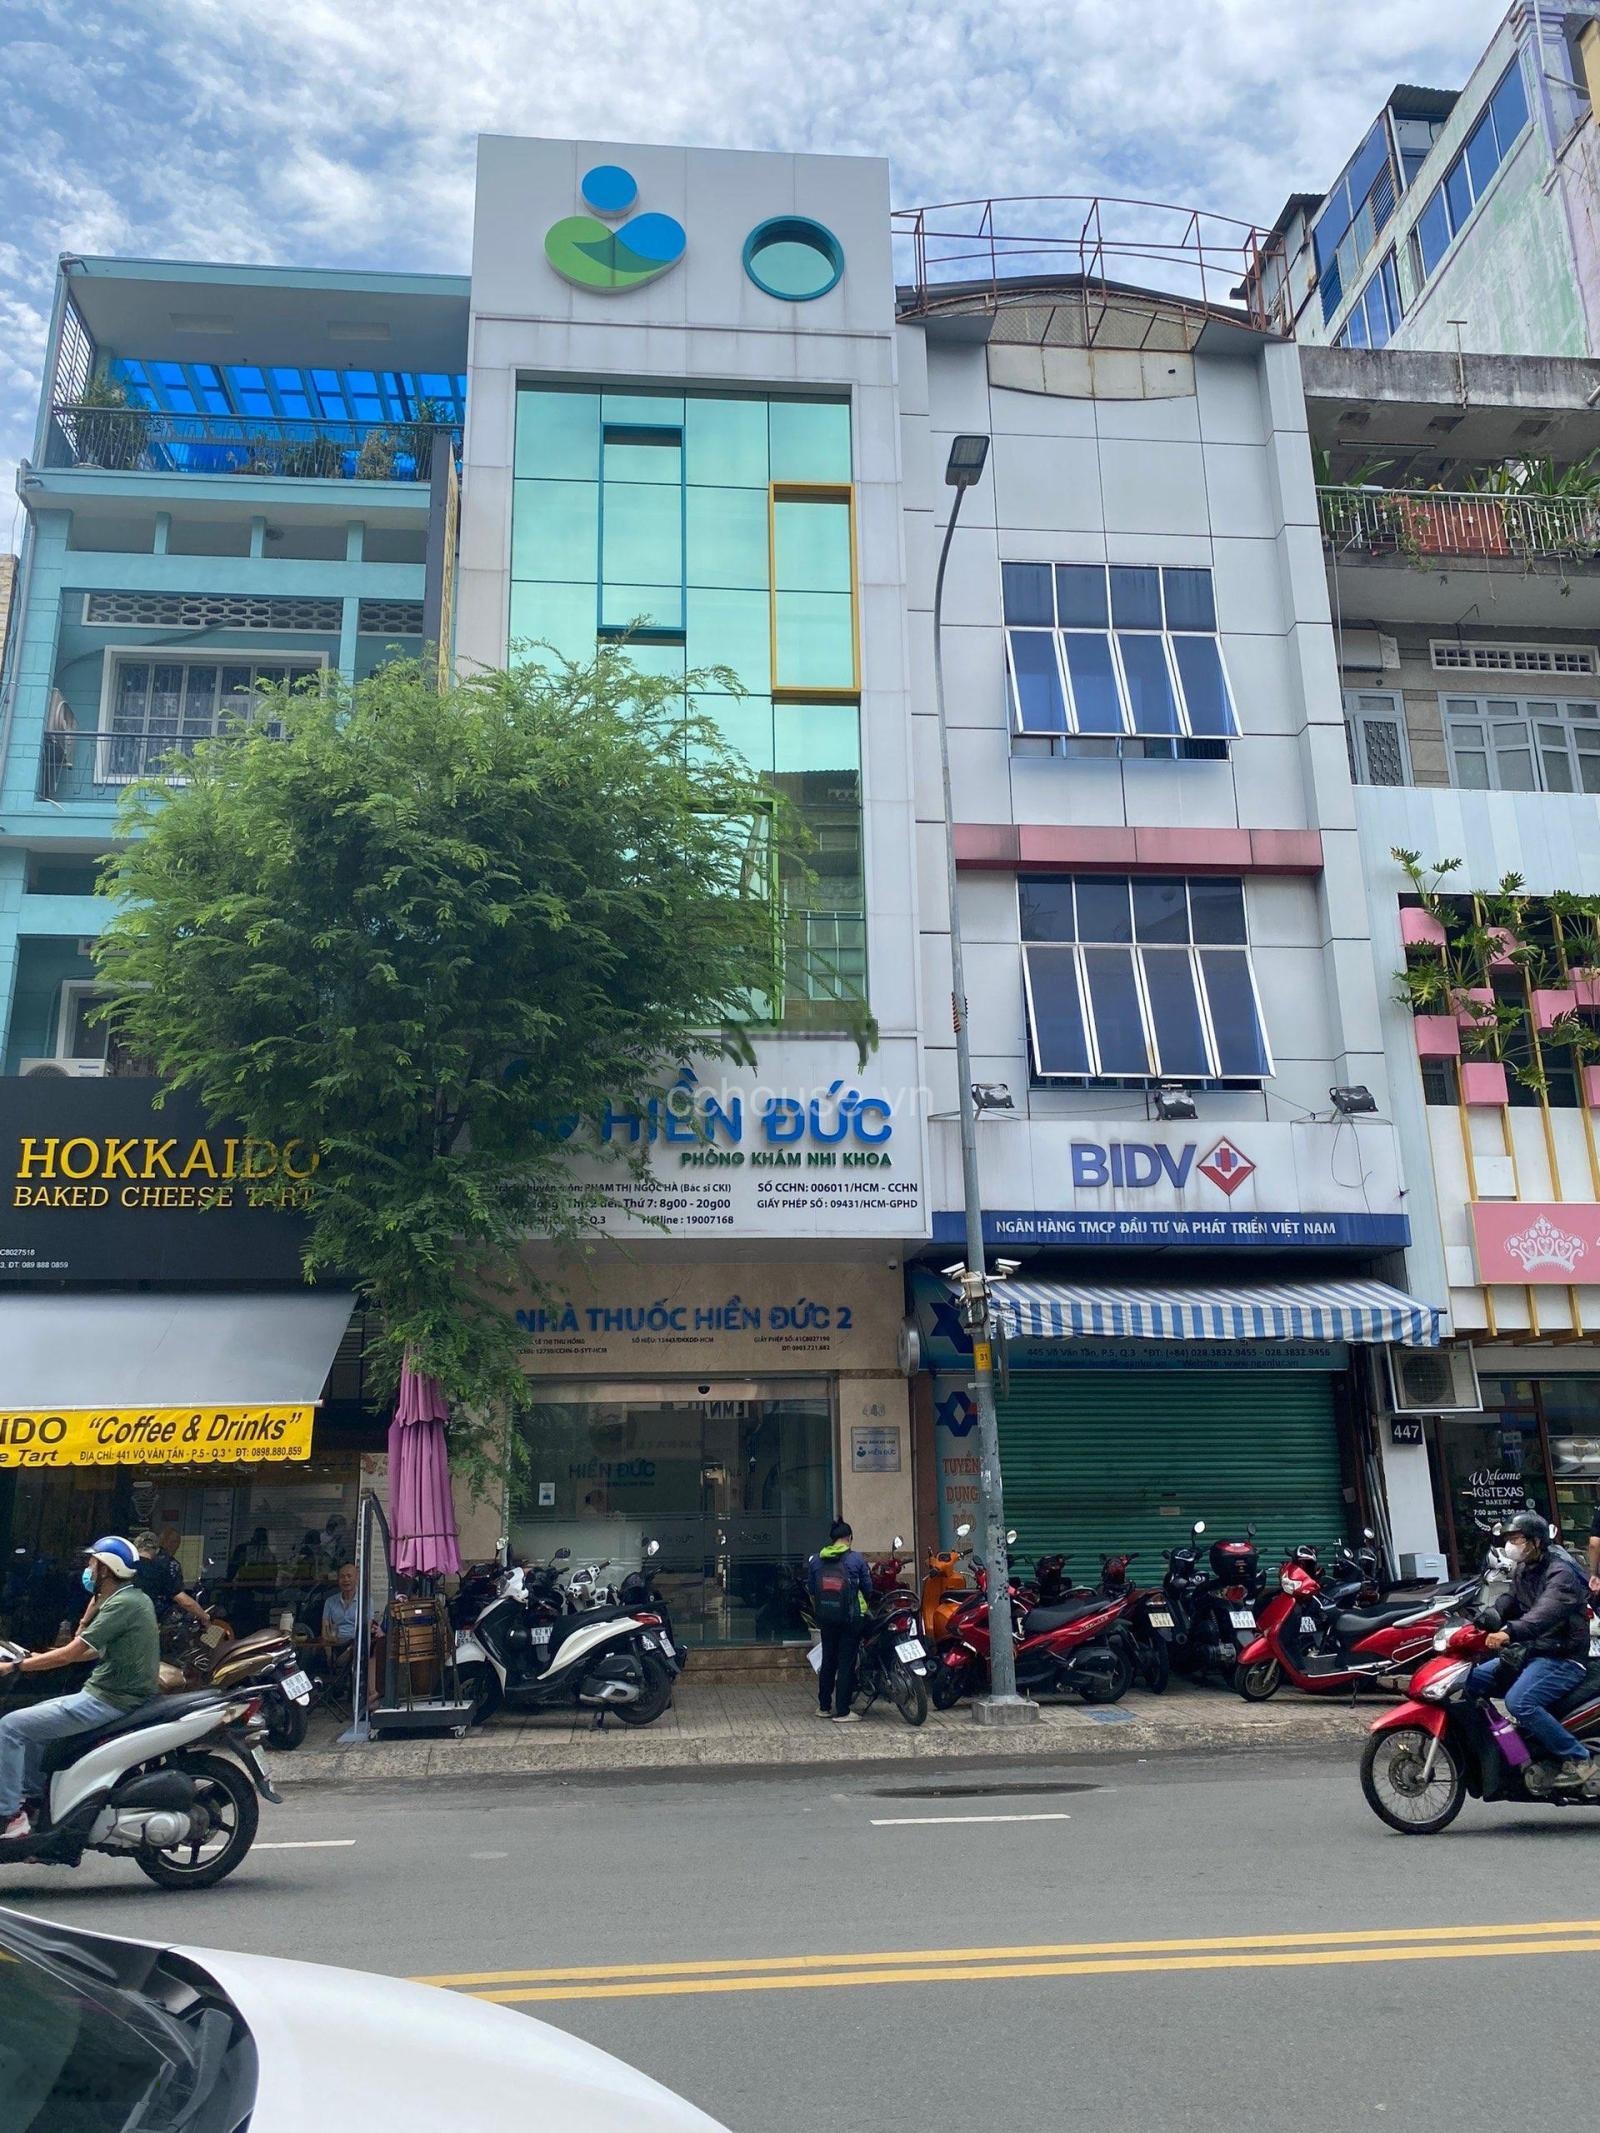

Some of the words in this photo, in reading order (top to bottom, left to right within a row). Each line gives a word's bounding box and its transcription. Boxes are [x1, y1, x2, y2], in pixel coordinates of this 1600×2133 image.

[602, 1068, 743, 1145] HIỀN
[762, 1080, 893, 1145] ĐỨC
[16, 1137, 320, 1180] HOKKAIDO
[681, 1149, 745, 1168] PHÒNG
[751, 1149, 801, 1168] KHÁM
[807, 1152, 837, 1168] NHI
[843, 1152, 893, 1168] KHOA
[1070, 1143, 1197, 1189] BIDV
[680, 1183, 702, 1194] (Bác
[757, 1180, 773, 1192] SỐ
[775, 1183, 809, 1192] CCHN:
[811, 1182, 879, 1192] 006011/HCM
[887, 1183, 918, 1192] CCHN
[13, 1186, 110, 1208] BAKED
[120, 1186, 234, 1208] CHEESE
[647, 1199, 658, 1208] 7:
[659, 1199, 688, 1210] 8g00
[697, 1199, 731, 1210] 20g00
[757, 1197, 780, 1208] GIẤY
[782, 1197, 808, 1208] PHÉP
[810, 1197, 824, 1208] SỐ
[830, 1199, 918, 1208] 09431/HCM-GPHD
[686, 1215, 734, 1225] 19007168
[996, 1217, 1034, 1233] NGÂN
[1037, 1218, 1076, 1234] HÀNG
[1079, 1222, 1116, 1234] TMCP
[1119, 1216, 1147, 1234] ĐẦU
[1150, 1220, 1170, 1234] TƯ
[1172, 1218, 1189, 1234] VÀ
[1192, 1217, 1228, 1234] PHÁT
[1231, 1215, 1267, 1234] TRIỂN
[1270, 1219, 1301, 1238] VIỆT
[1304, 1222, 1336, 1234] NAM
[585, 1298, 688, 1332] THUỐC
[694, 1295, 761, 1331] HIỀN
[768, 1297, 830, 1330] ĐỨC
[836, 1306, 853, 1330] 2
[182, 1414, 200, 1444] &
[1393, 1425, 1419, 1439] 447
[18, 1449, 59, 1463] Tart
[80, 1449, 95, 1461] ĐỊA
[117, 1448, 131, 1459] 441
[191, 1448, 205, 1459] P.5
[211, 1448, 227, 1459] Q.3
[236, 1447, 250, 1458] ĐT:
[251, 1445, 303, 1457] 0898.880.859
[1468, 1468, 1521, 1486] Welcome
